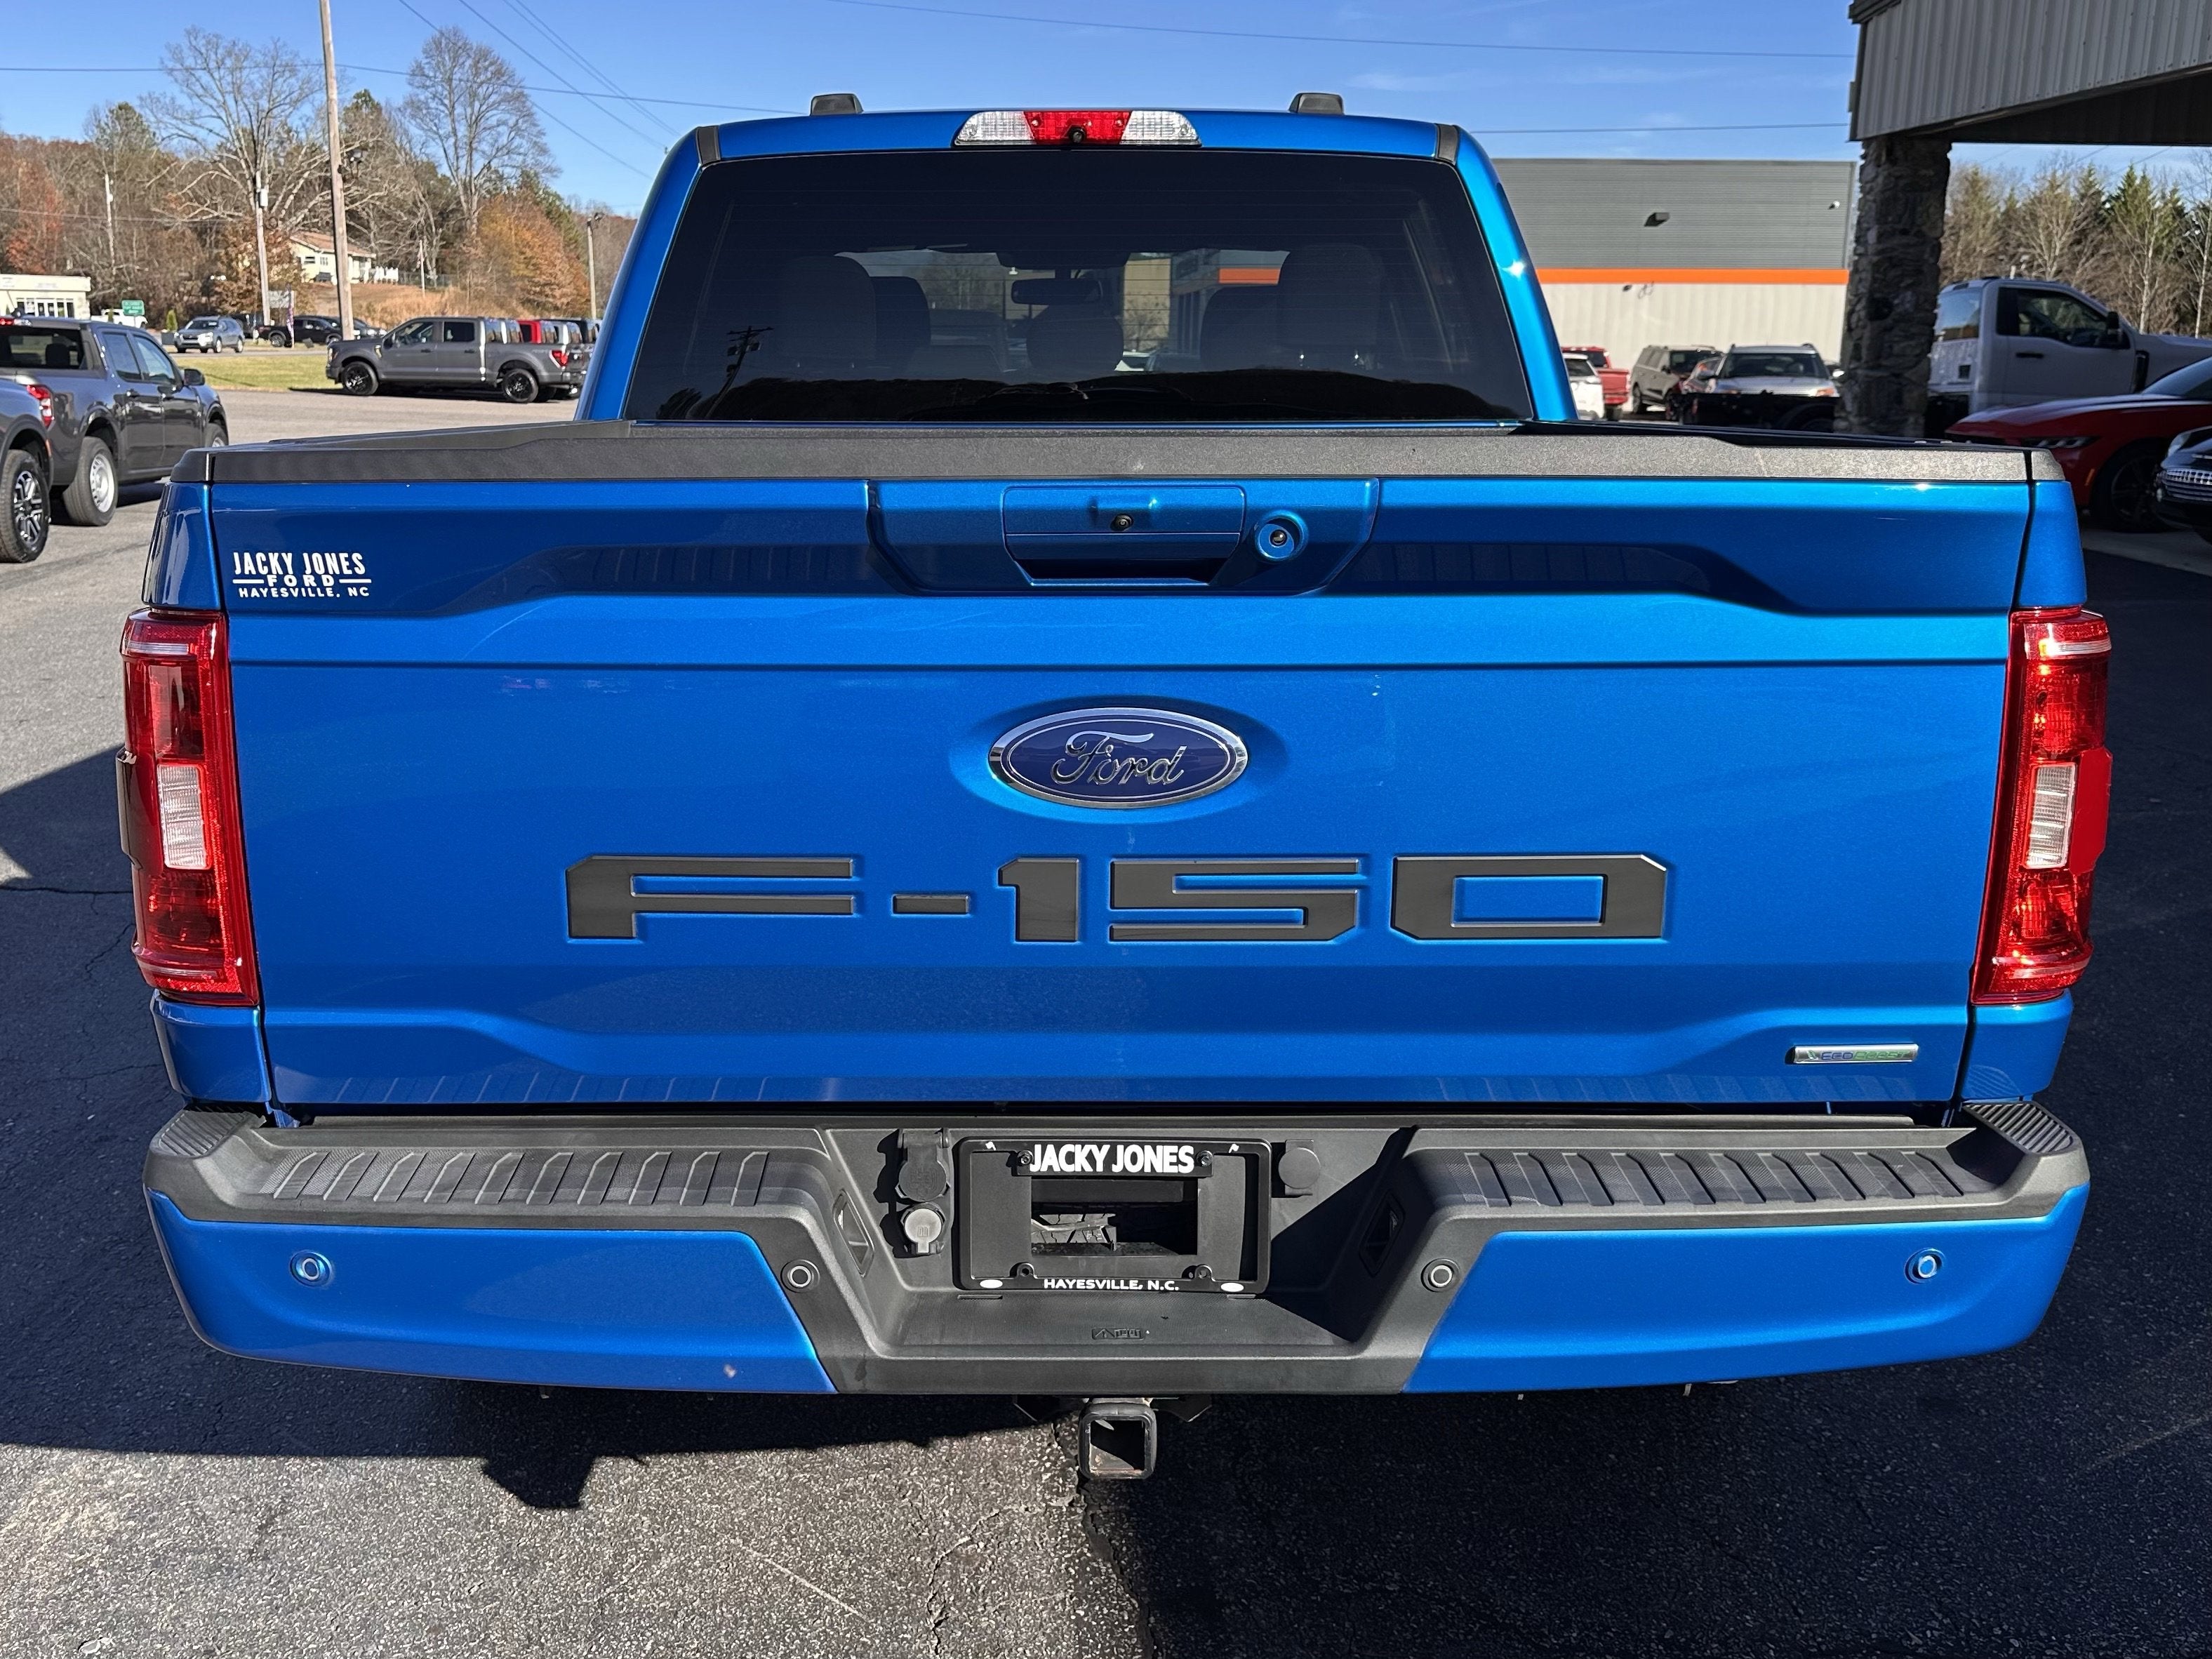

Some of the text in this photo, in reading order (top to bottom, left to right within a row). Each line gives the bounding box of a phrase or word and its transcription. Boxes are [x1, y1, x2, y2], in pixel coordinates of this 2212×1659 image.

[233, 552, 366, 575] JACKY JONES
[267, 574, 335, 587] FORD
[347, 587, 370, 597] NC
[1052, 730, 1185, 785] Ford
[565, 855, 1669, 945] F-150
[1030, 1144, 1194, 1173] JACKY JONES
[1044, 1279, 1180, 1291] HAYESVILLE, N.C.
